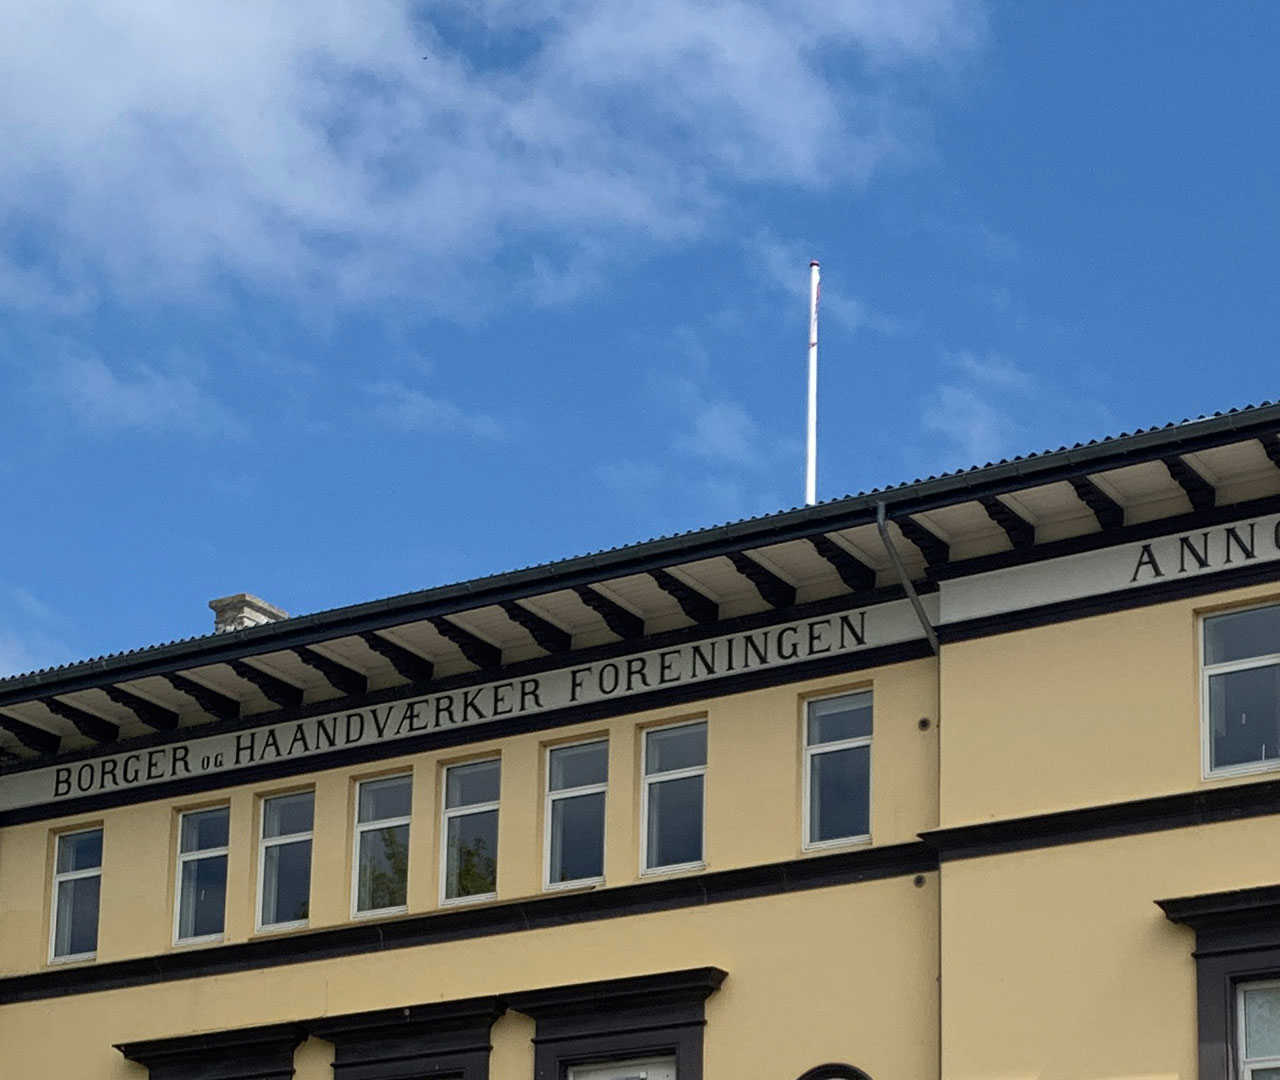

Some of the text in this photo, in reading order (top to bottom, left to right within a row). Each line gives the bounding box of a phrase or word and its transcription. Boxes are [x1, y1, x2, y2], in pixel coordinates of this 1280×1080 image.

[53, 611, 867, 798] BORGER OG HAANDVÆRKER FORENINGEN
